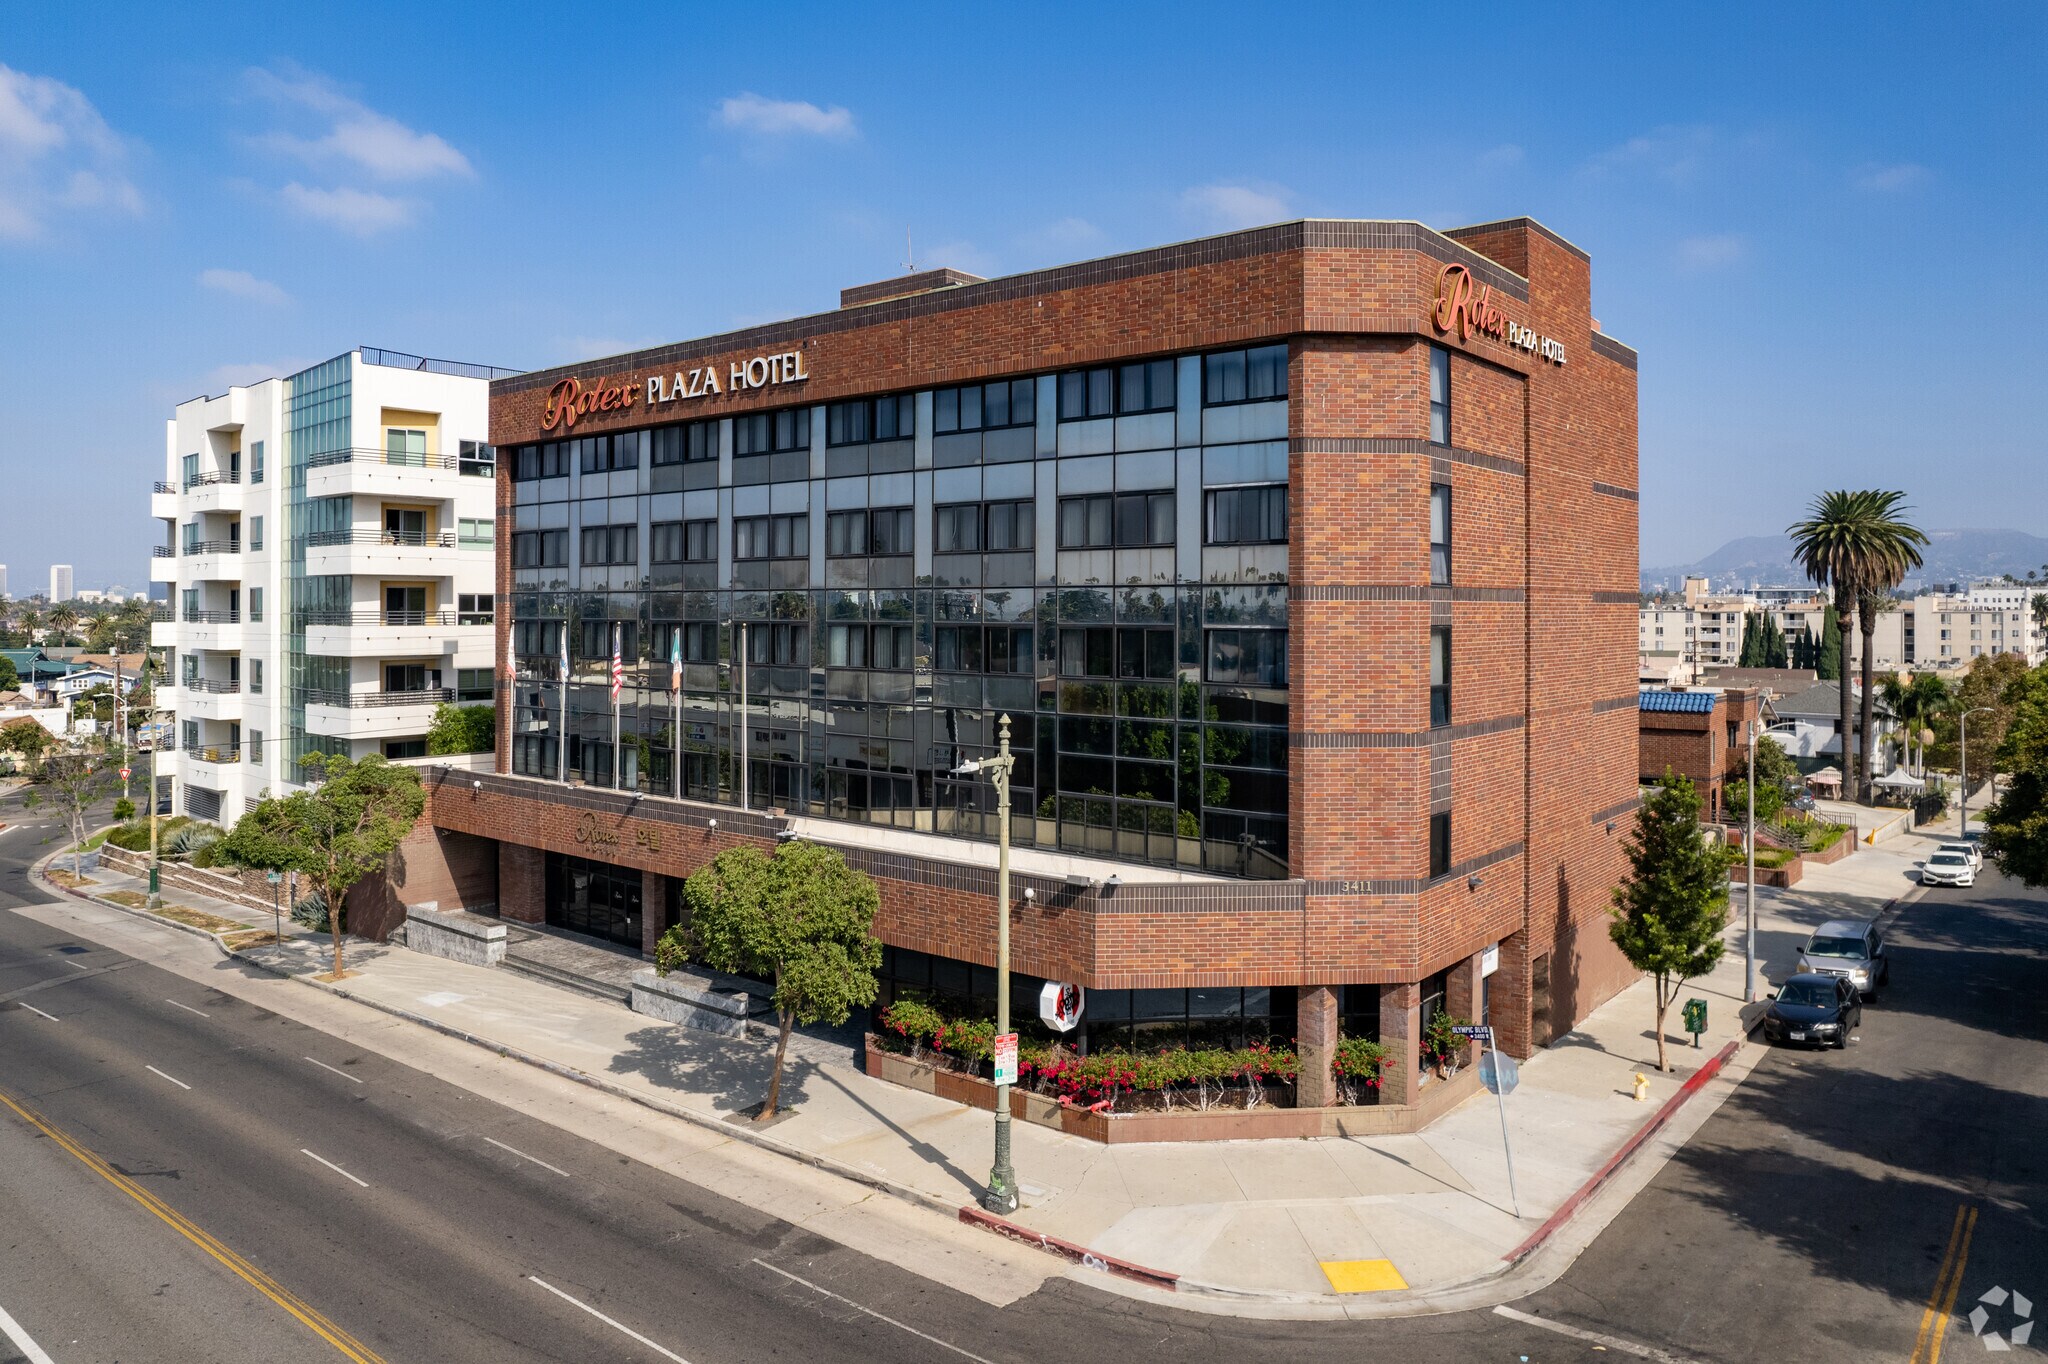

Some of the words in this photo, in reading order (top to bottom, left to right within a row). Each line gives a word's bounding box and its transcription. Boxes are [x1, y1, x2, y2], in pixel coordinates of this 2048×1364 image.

[1432, 262, 1506, 340] Rotex
[1509, 321, 1538, 352] PLAZA
[1541, 335, 1566, 364] HOTEL
[542, 376, 640, 431] Rotex
[647, 366, 722, 404] PLAZA
[730, 350, 810, 392] HOTEL
[1341, 880, 1372, 892] 3411
